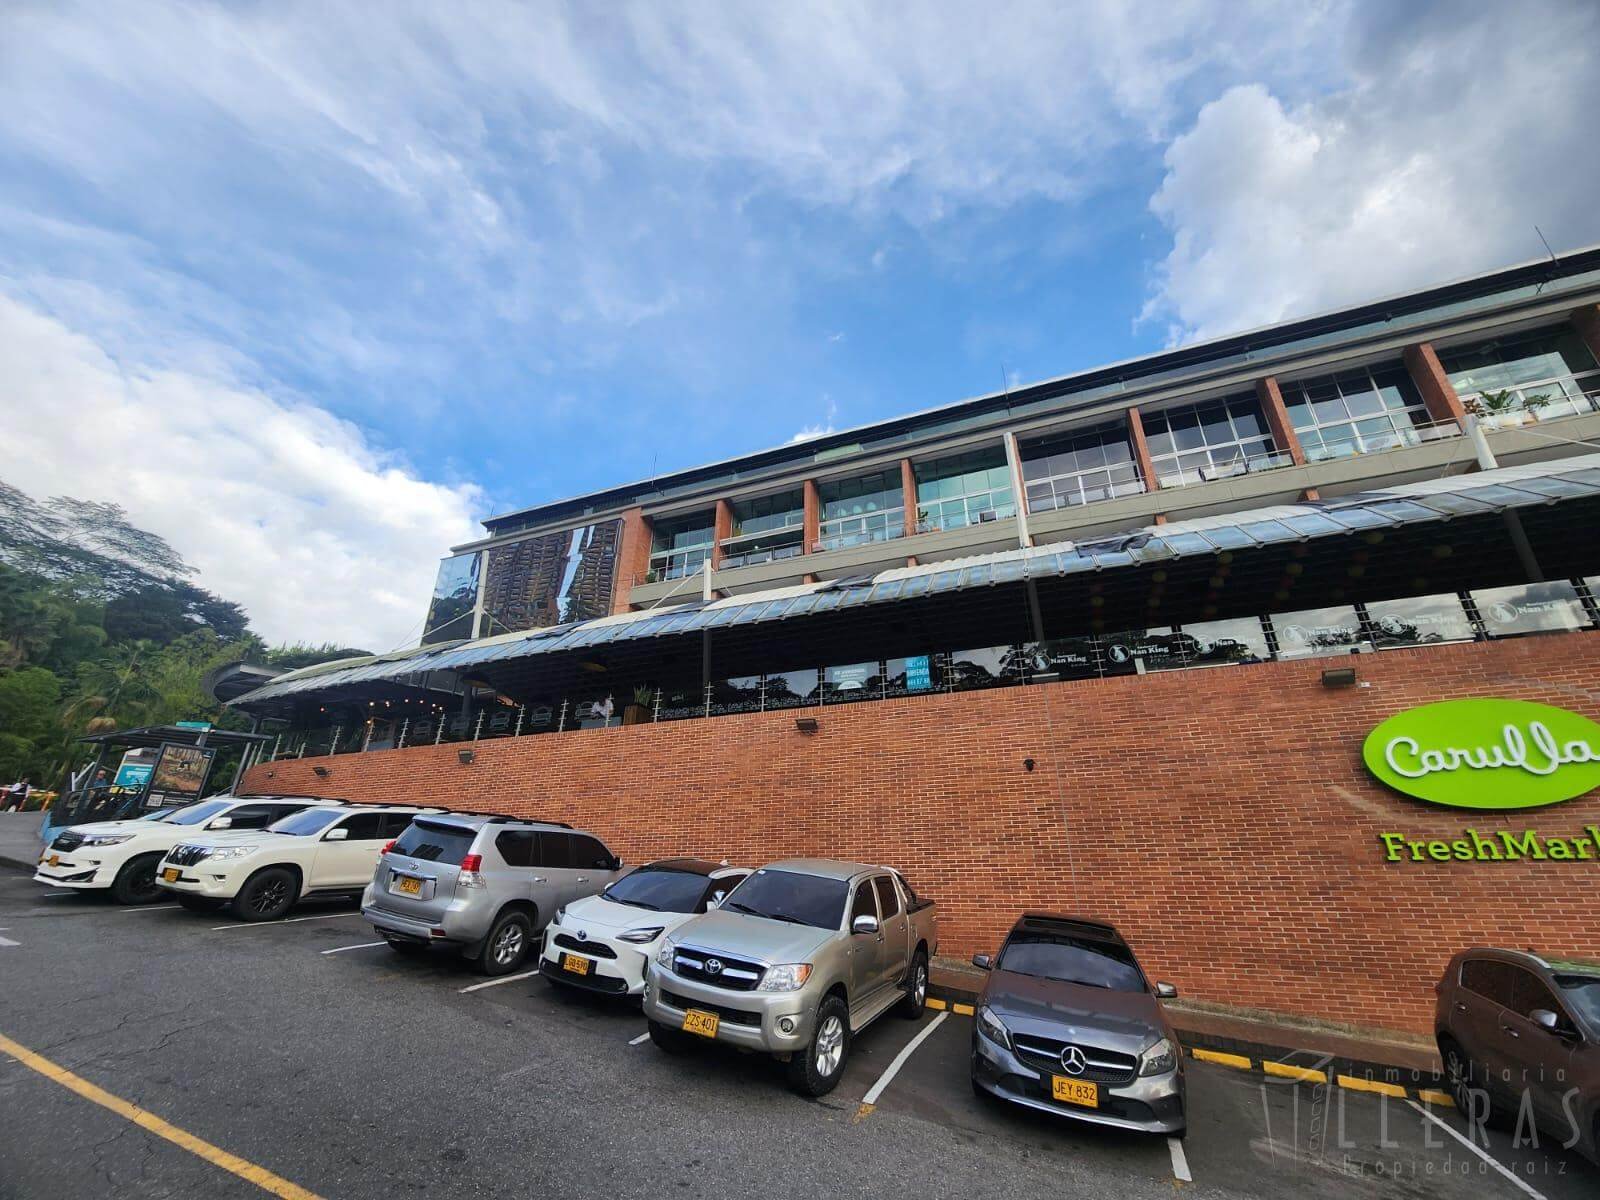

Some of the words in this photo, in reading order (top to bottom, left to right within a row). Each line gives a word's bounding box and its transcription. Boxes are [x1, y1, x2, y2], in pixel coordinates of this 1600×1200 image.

[1130, 648, 1147, 656] Nan
[1148, 646, 1169, 654] King
[1385, 720, 1600, 778] Carulla
[702, 1017, 716, 1032] 401
[1055, 1081, 1073, 1096] JEY
[1076, 1086, 1096, 1100] 832
